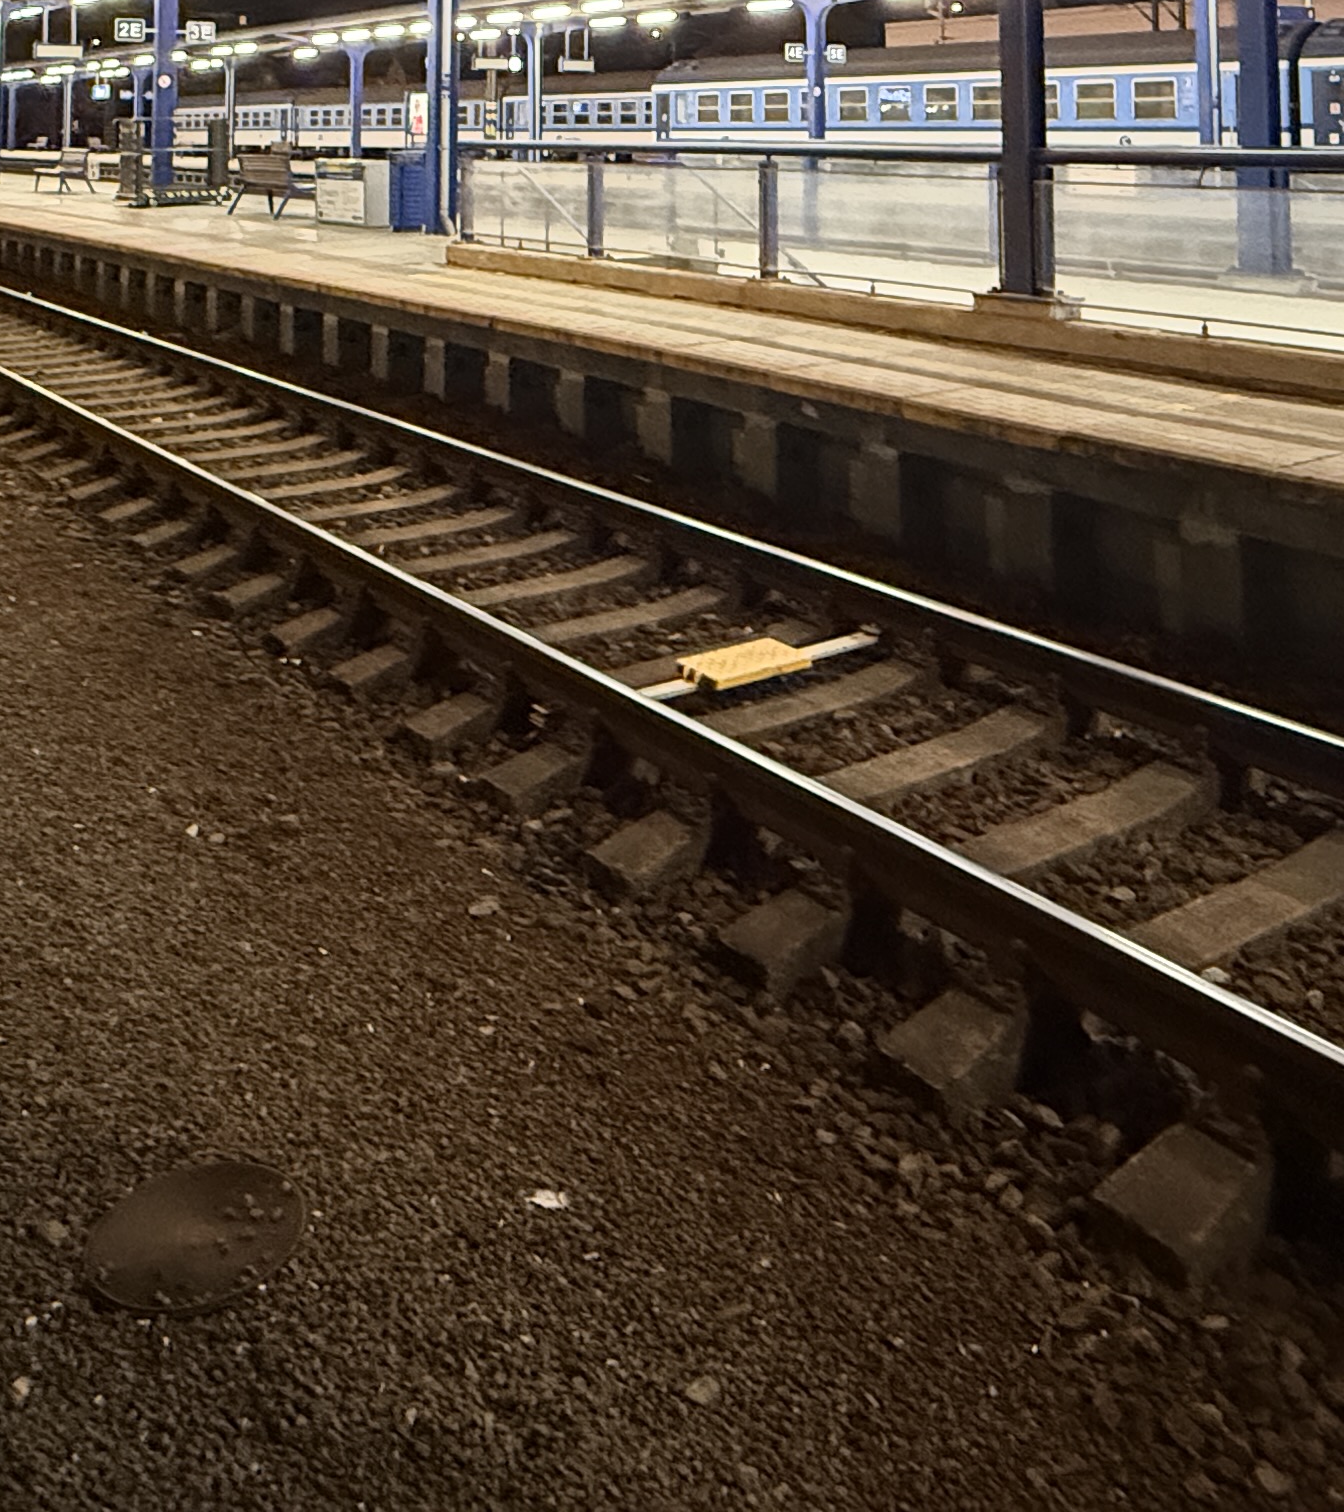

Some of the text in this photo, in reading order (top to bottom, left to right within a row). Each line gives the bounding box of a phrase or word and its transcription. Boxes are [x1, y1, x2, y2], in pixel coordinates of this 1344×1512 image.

[119, 22, 142, 38] 2E
[189, 24, 213, 40] 3E
[788, 46, 804, 59] 4E
